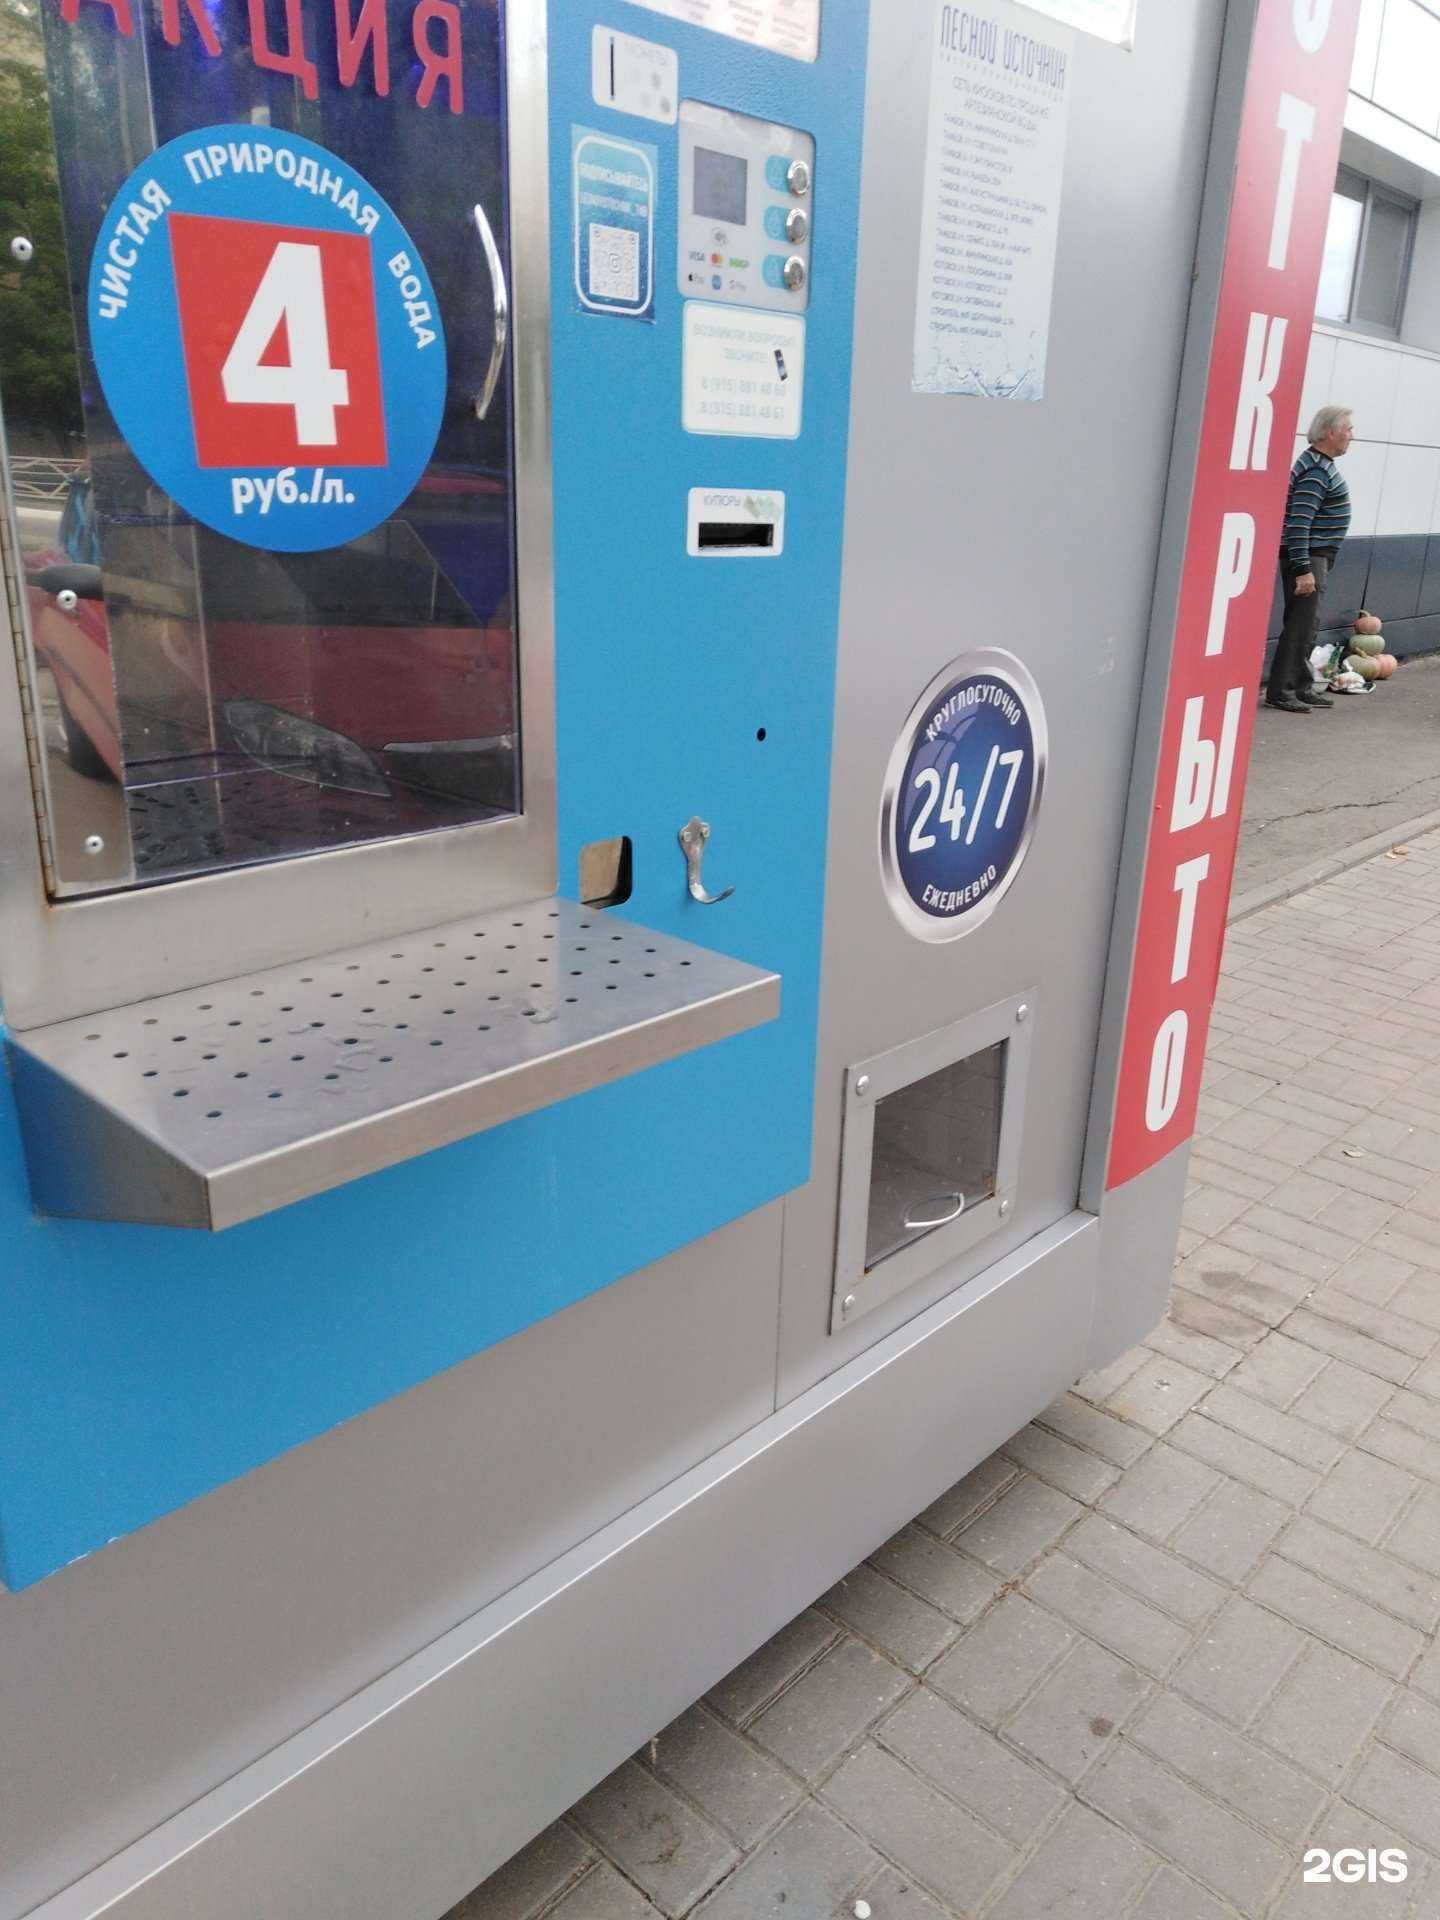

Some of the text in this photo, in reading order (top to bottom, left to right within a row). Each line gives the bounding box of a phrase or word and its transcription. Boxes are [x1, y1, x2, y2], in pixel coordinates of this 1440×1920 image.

[99, 142, 437, 350] ЧИСТАЯ ПРИРОДНАЯ ВОДА
[221, 242, 350, 446] 4
[232, 468, 355, 514] руб./л.
[926, 684, 1021, 742] КРУГЛОСУТОЧНО
[909, 744, 1024, 853] 24/7
[922, 864, 997, 911] ЕЖЕДНЕВНО
